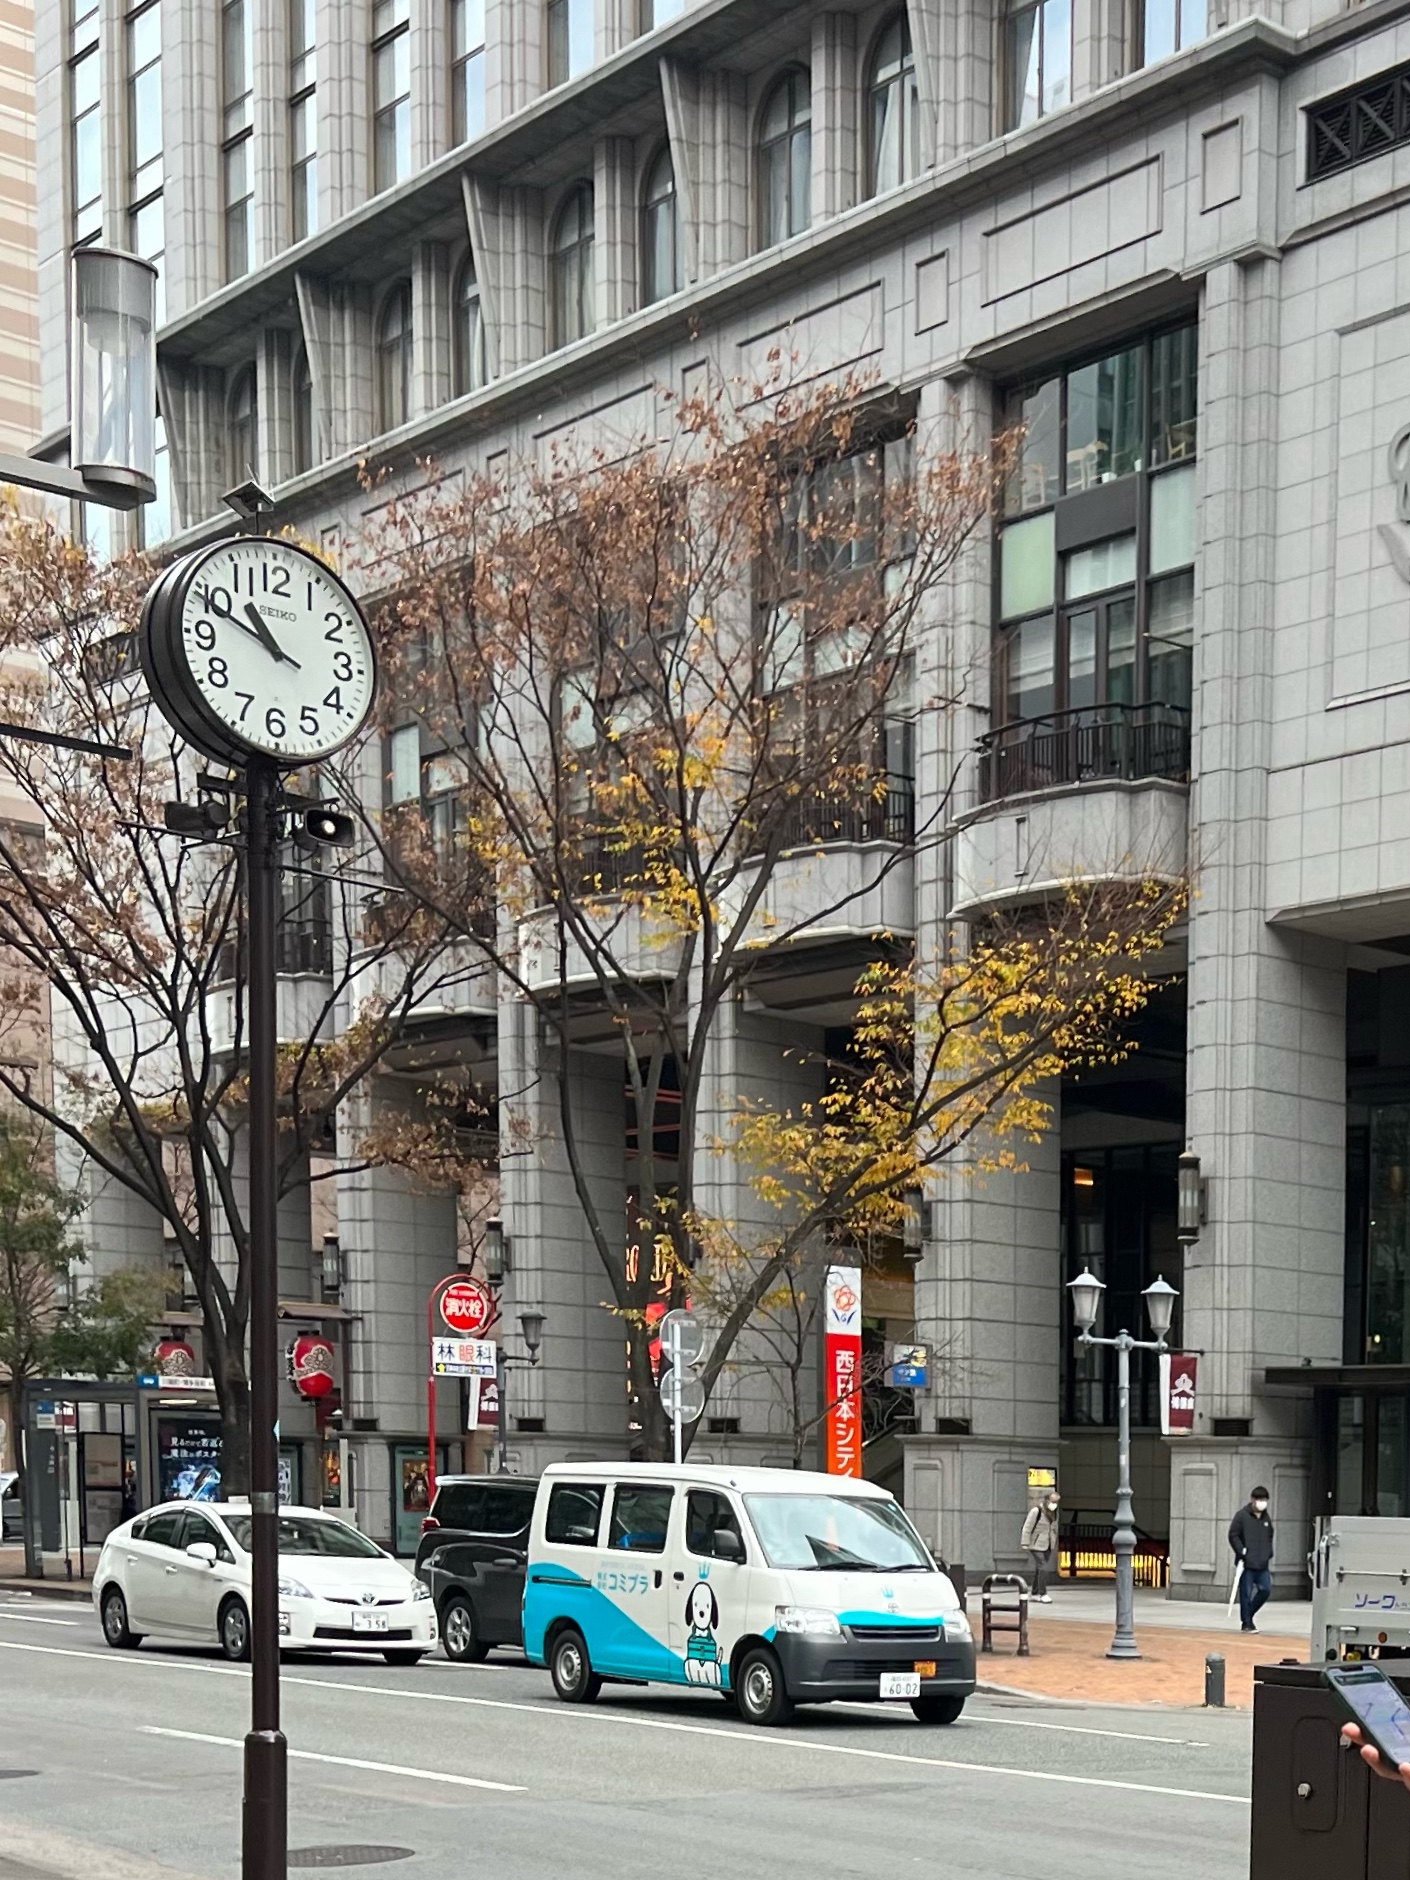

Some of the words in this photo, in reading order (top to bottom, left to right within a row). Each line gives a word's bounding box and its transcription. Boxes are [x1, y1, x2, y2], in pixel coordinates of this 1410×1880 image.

[233, 563, 254, 597] 11
[263, 562, 292, 598] 12
[203, 584, 233, 619] 10
[307, 582, 313, 611] 1
[258, 604, 297, 623] SEIKO
[324, 612, 344, 644] 2
[195, 620, 217, 651] 9
[207, 656, 229, 689] 8
[333, 651, 354, 682] 3
[234, 691, 256, 722] 7
[322, 686, 345, 716] 4
[265, 707, 287, 738] 6
[299, 705, 320, 736] 5
[445, 1297, 483, 1319] 消火栓
[436, 1342, 492, 1364] 林眼科
